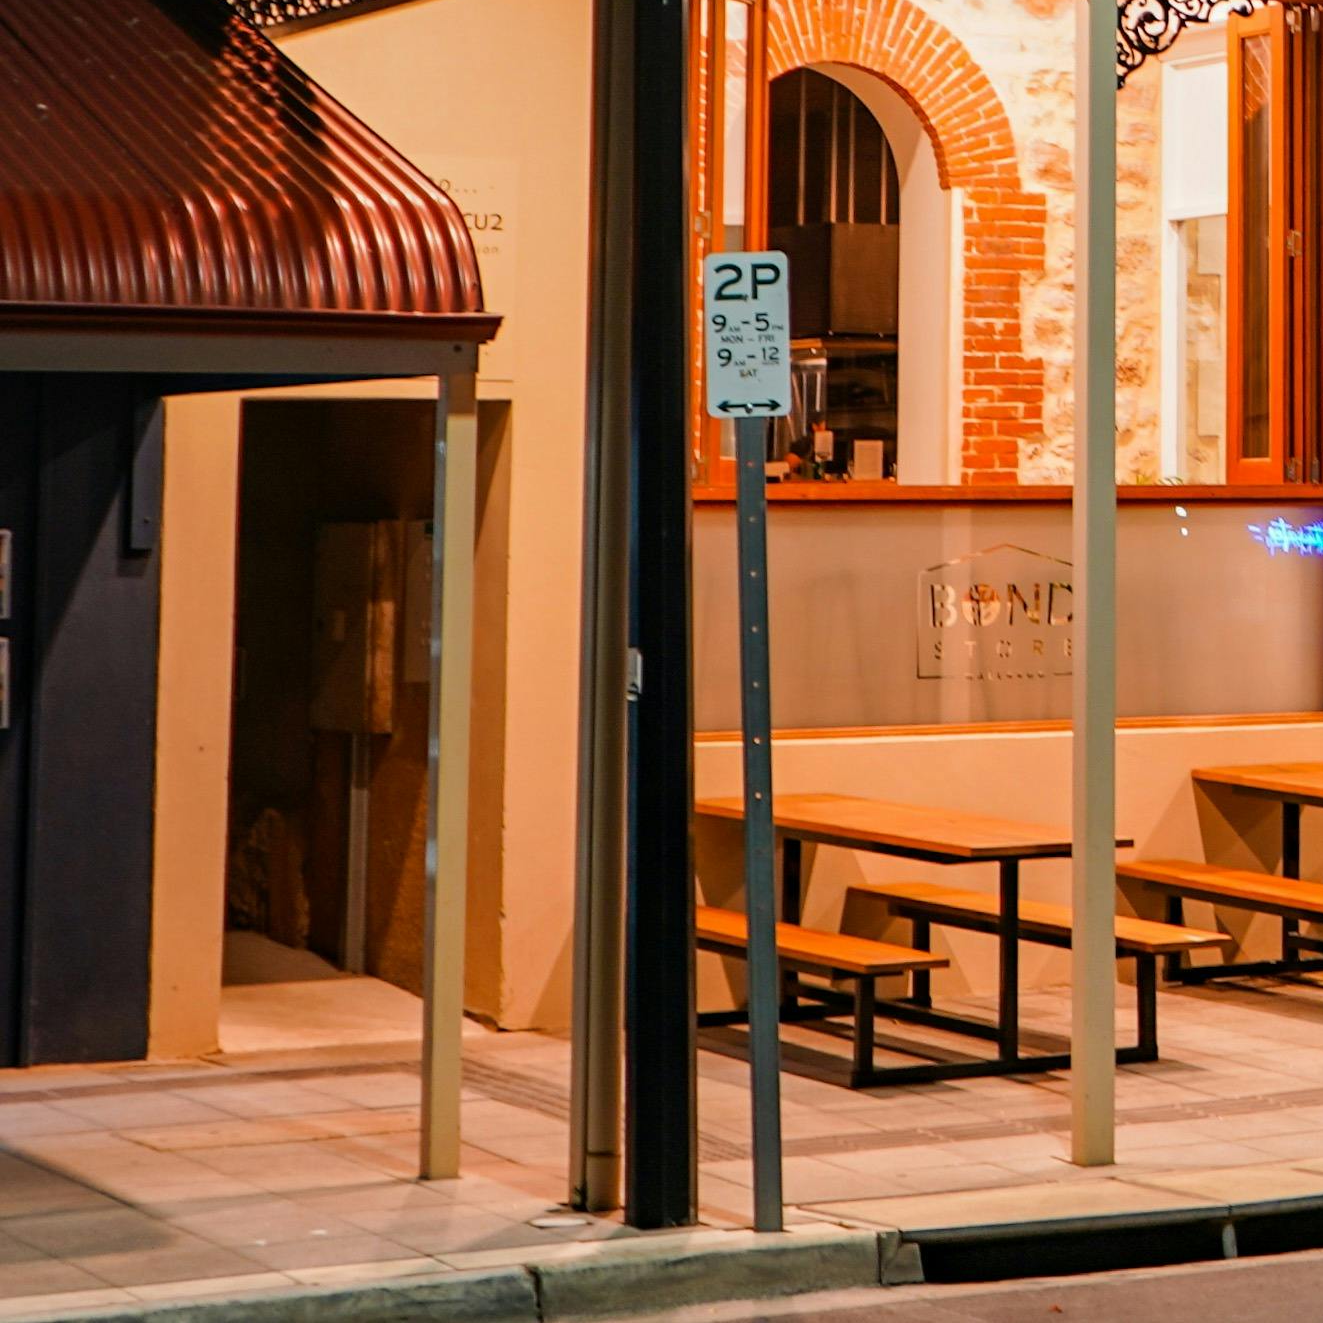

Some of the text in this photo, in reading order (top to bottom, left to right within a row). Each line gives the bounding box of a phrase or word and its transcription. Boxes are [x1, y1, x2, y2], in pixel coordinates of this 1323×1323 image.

[714, 262, 781, 301] 2P
[929, 582, 1073, 629] BOND
[933, 638, 1073, 661] STORE
